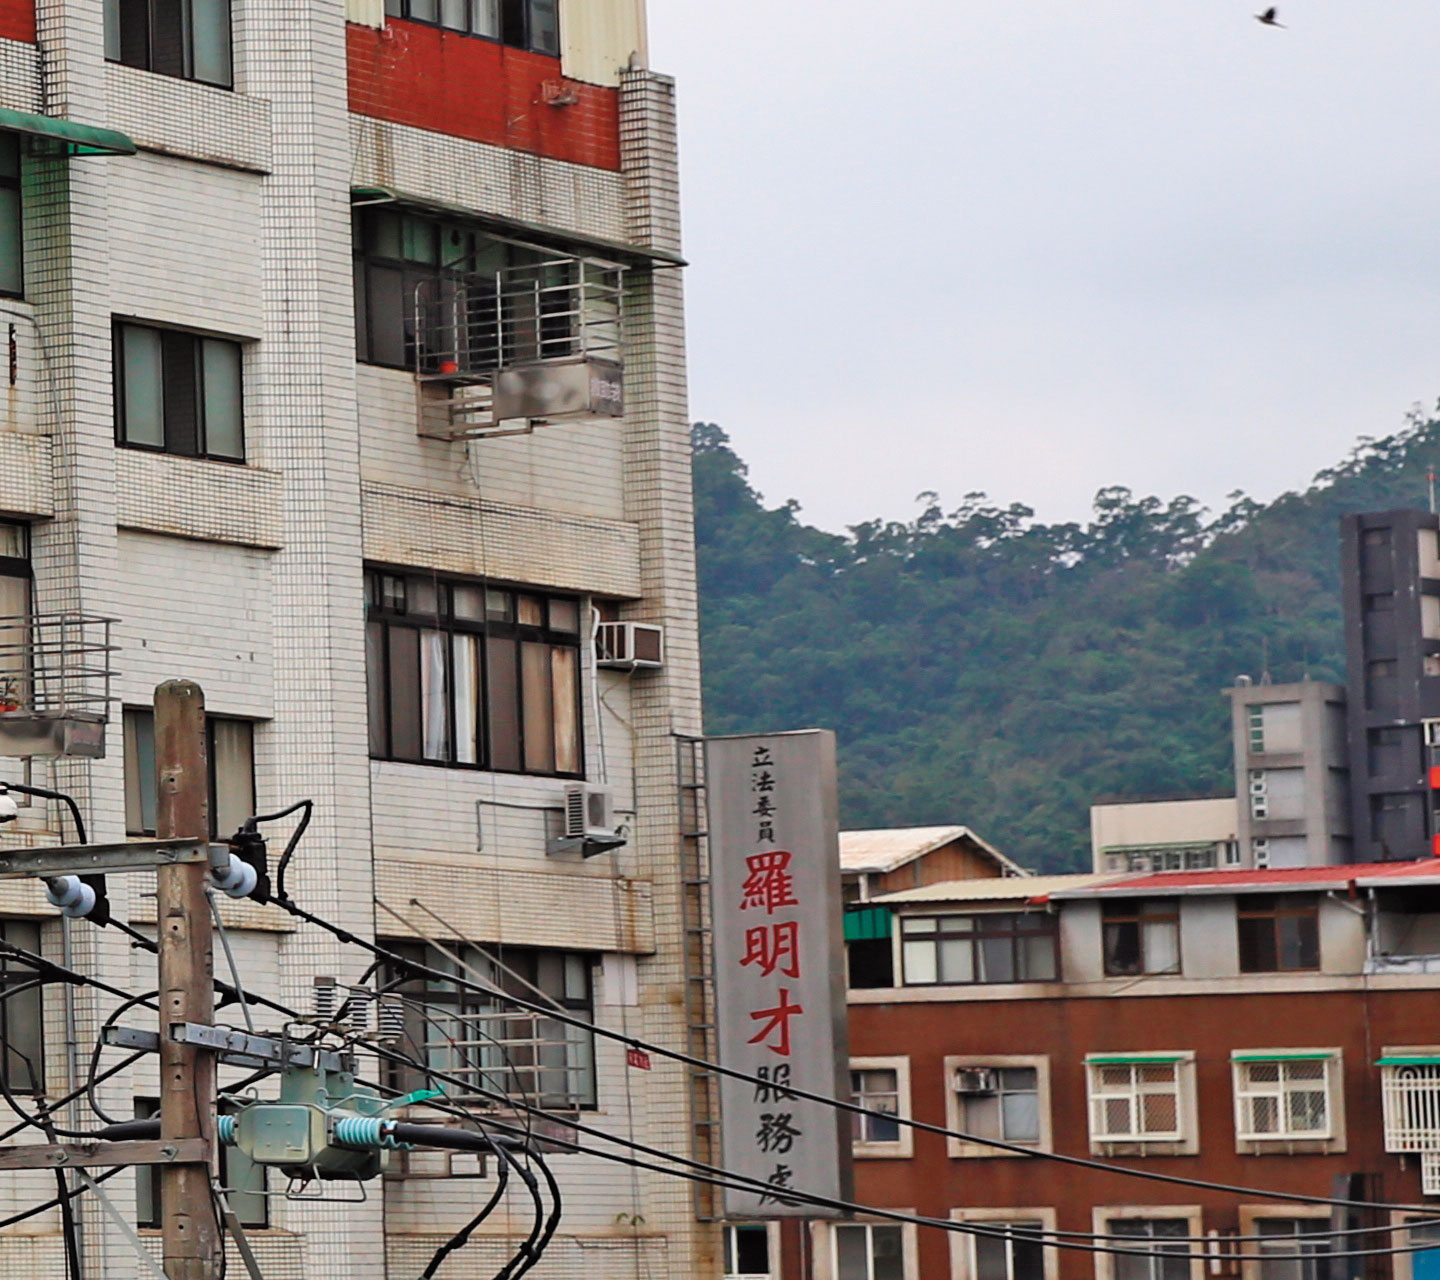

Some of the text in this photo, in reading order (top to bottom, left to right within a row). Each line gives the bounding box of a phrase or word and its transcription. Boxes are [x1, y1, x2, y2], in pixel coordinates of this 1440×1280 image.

[739, 746, 804, 1208] 立法委員 羅明才 服務處
